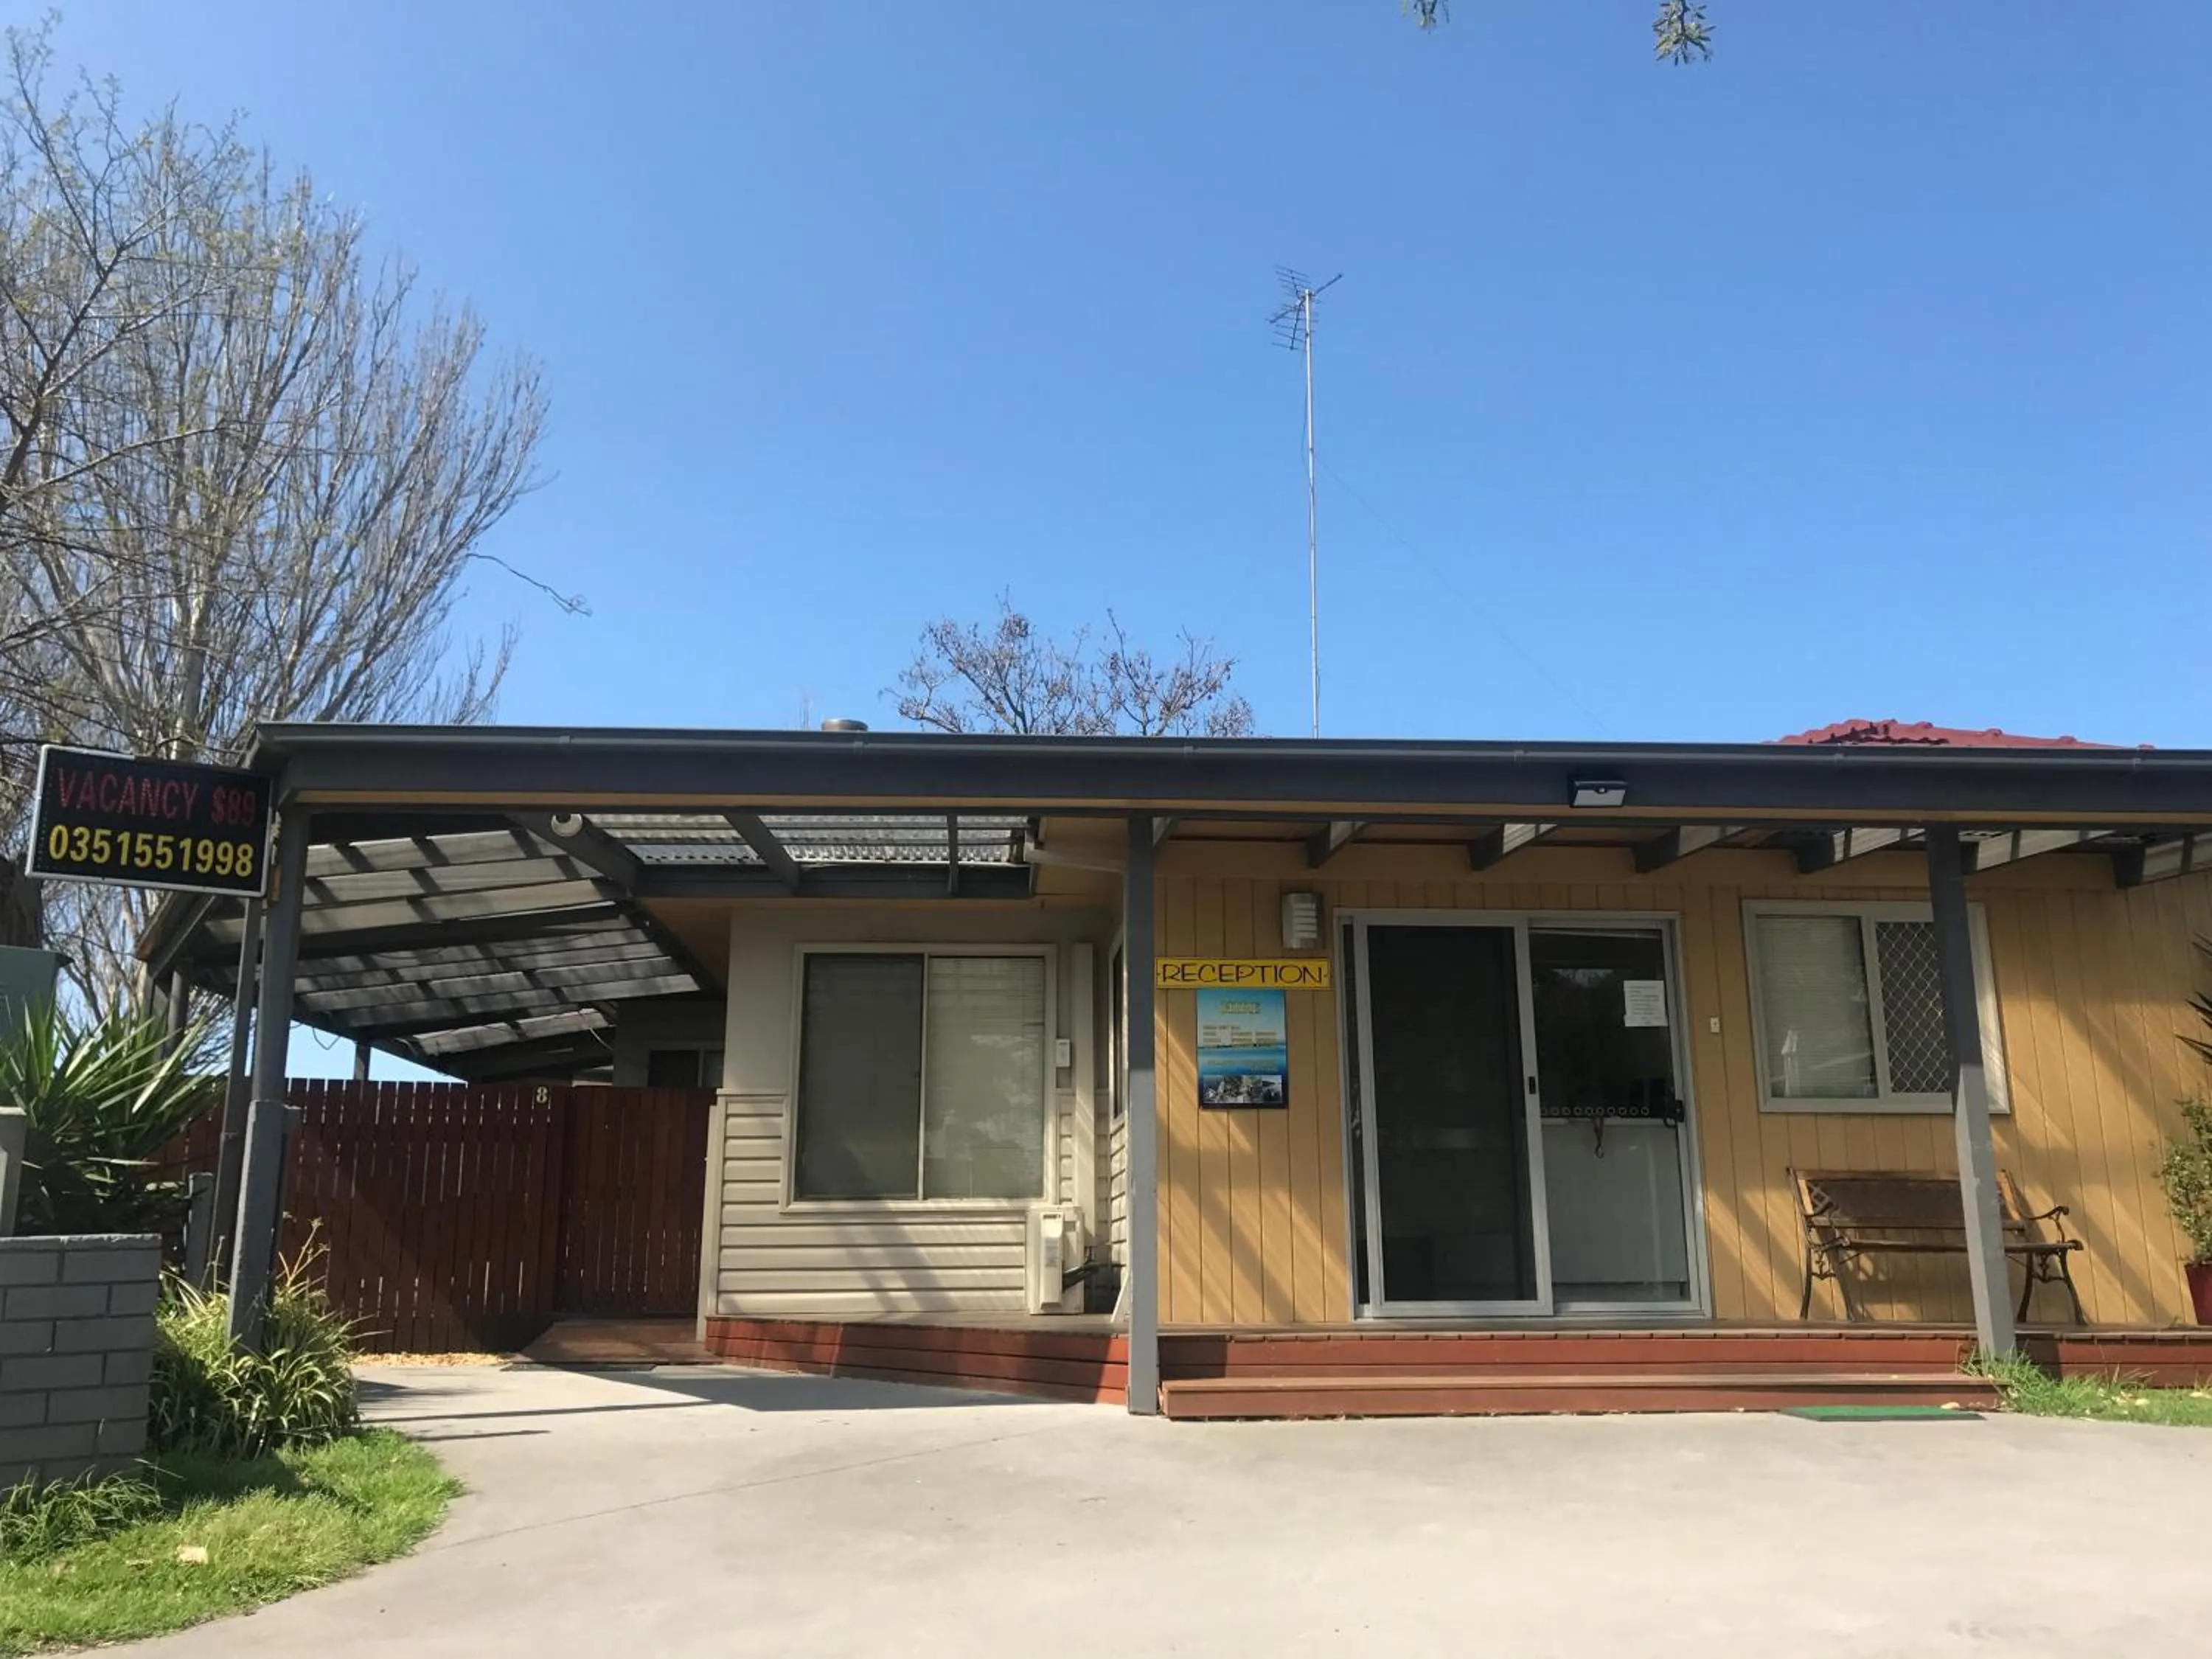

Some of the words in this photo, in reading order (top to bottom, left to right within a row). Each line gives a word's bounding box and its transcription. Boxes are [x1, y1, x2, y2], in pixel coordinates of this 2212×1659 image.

[57, 768, 198, 820] VACANCY
[49, 824, 254, 877] 0351551998
[1163, 964, 1322, 984] RECEPTION
[536, 1086, 548, 1104] 8
